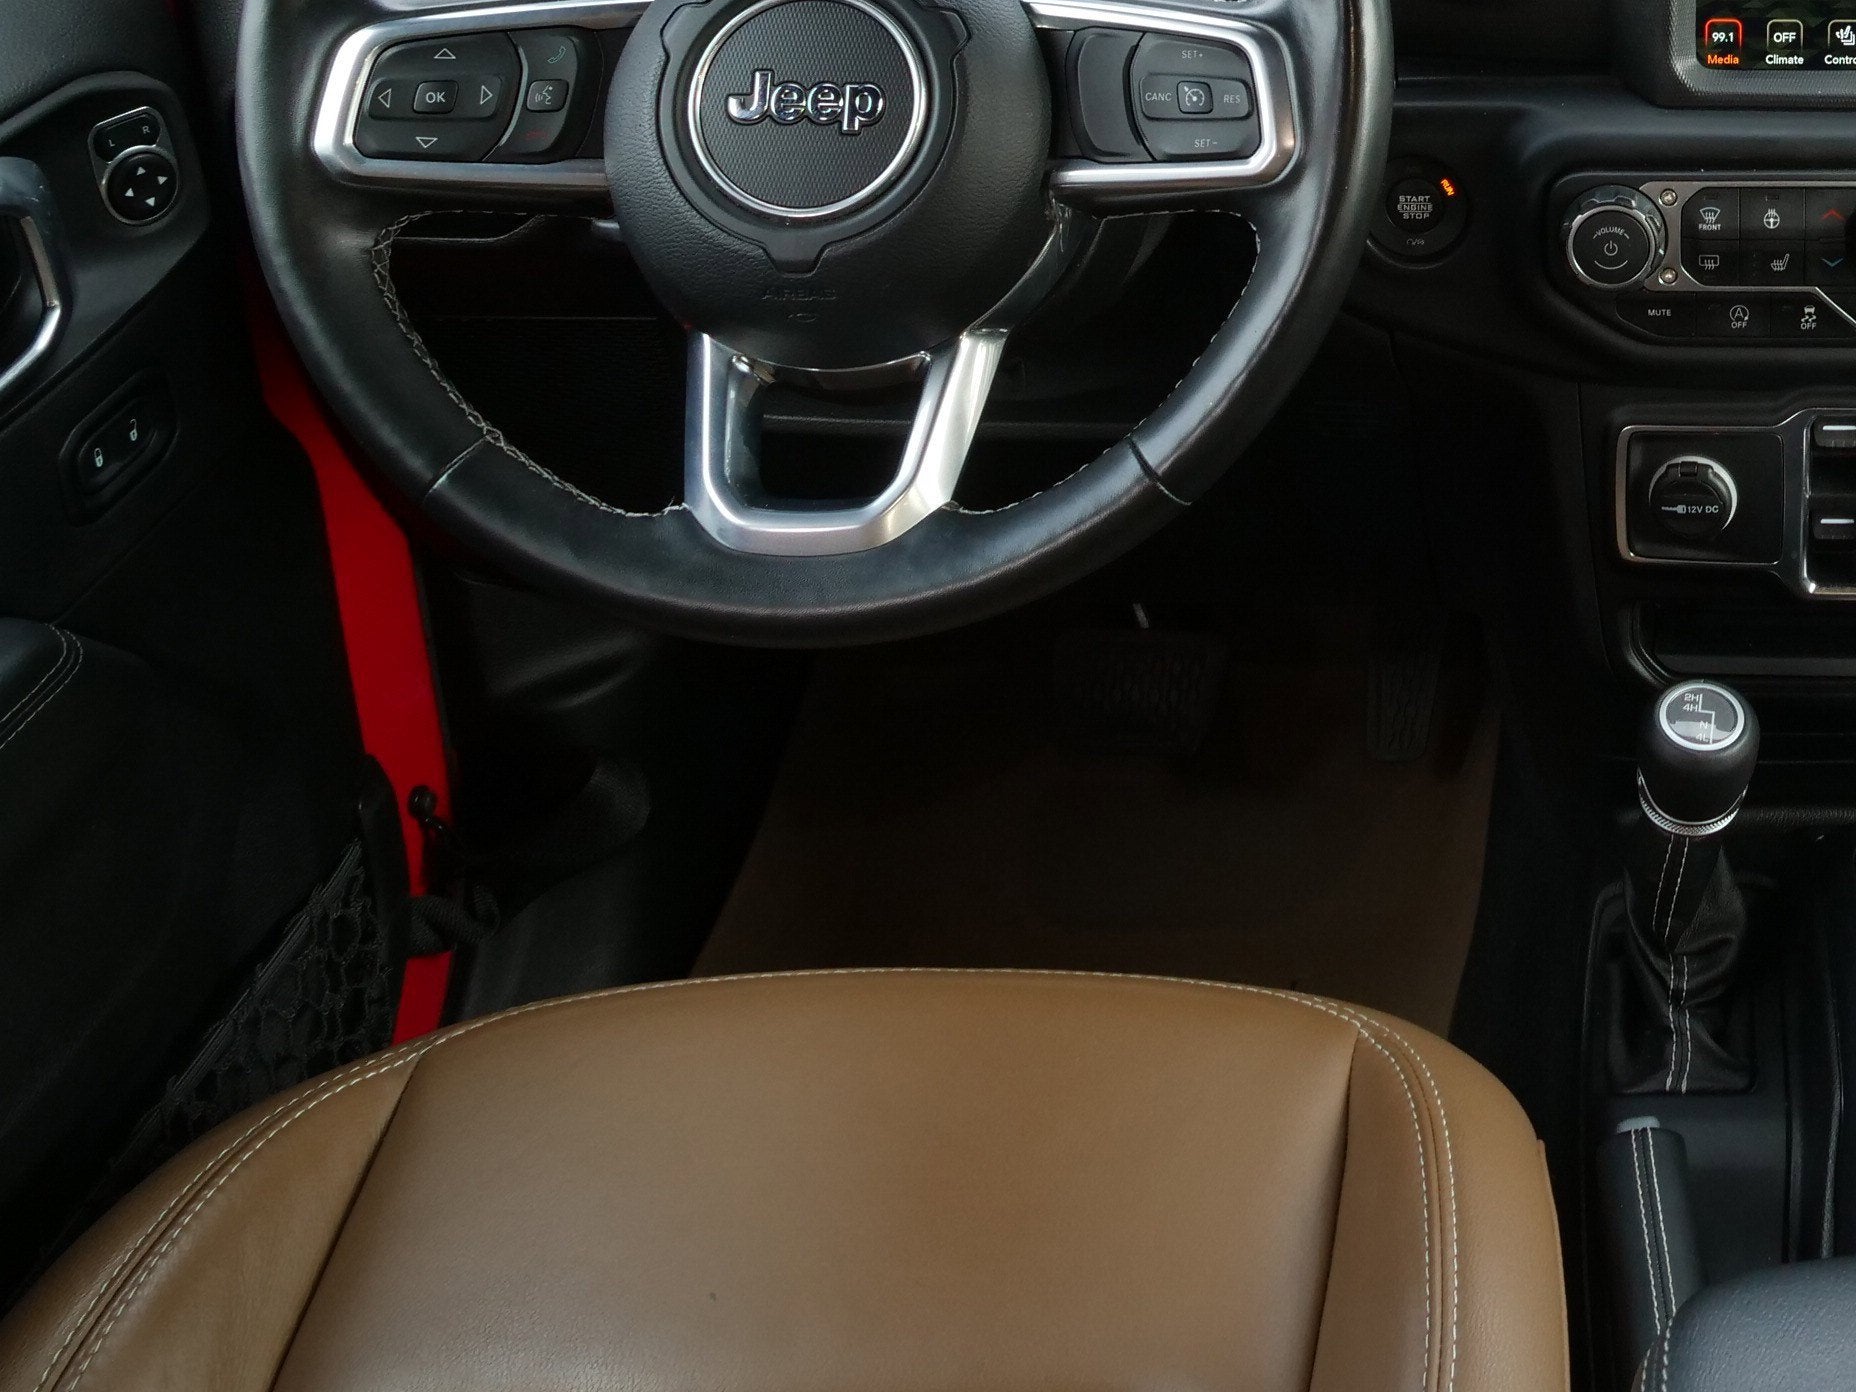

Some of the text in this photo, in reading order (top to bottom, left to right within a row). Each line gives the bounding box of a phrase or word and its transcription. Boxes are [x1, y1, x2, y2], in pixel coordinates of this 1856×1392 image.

[1712, 31, 1734, 43] 99.1
[1773, 31, 1796, 43] OFF
[1707, 53, 1739, 65] Media
[1766, 53, 1804, 66] Climate
[425, 90, 446, 104] OK
[727, 69, 886, 133] Jeep
[1145, 92, 1172, 101] CANC
[1223, 94, 1241, 103] RES
[142, 125, 151, 134] R
[108, 139, 116, 147] L
[1440, 179, 1454, 196] RUN
[1596, 227, 1625, 236] VOLUME
[1731, 321, 1747, 329] OFF
[1800, 321, 1817, 329] OFF
[1688, 504, 1719, 514] 12V DC
[1684, 693, 1699, 702] 2H
[1682, 704, 1698, 712] 4H
